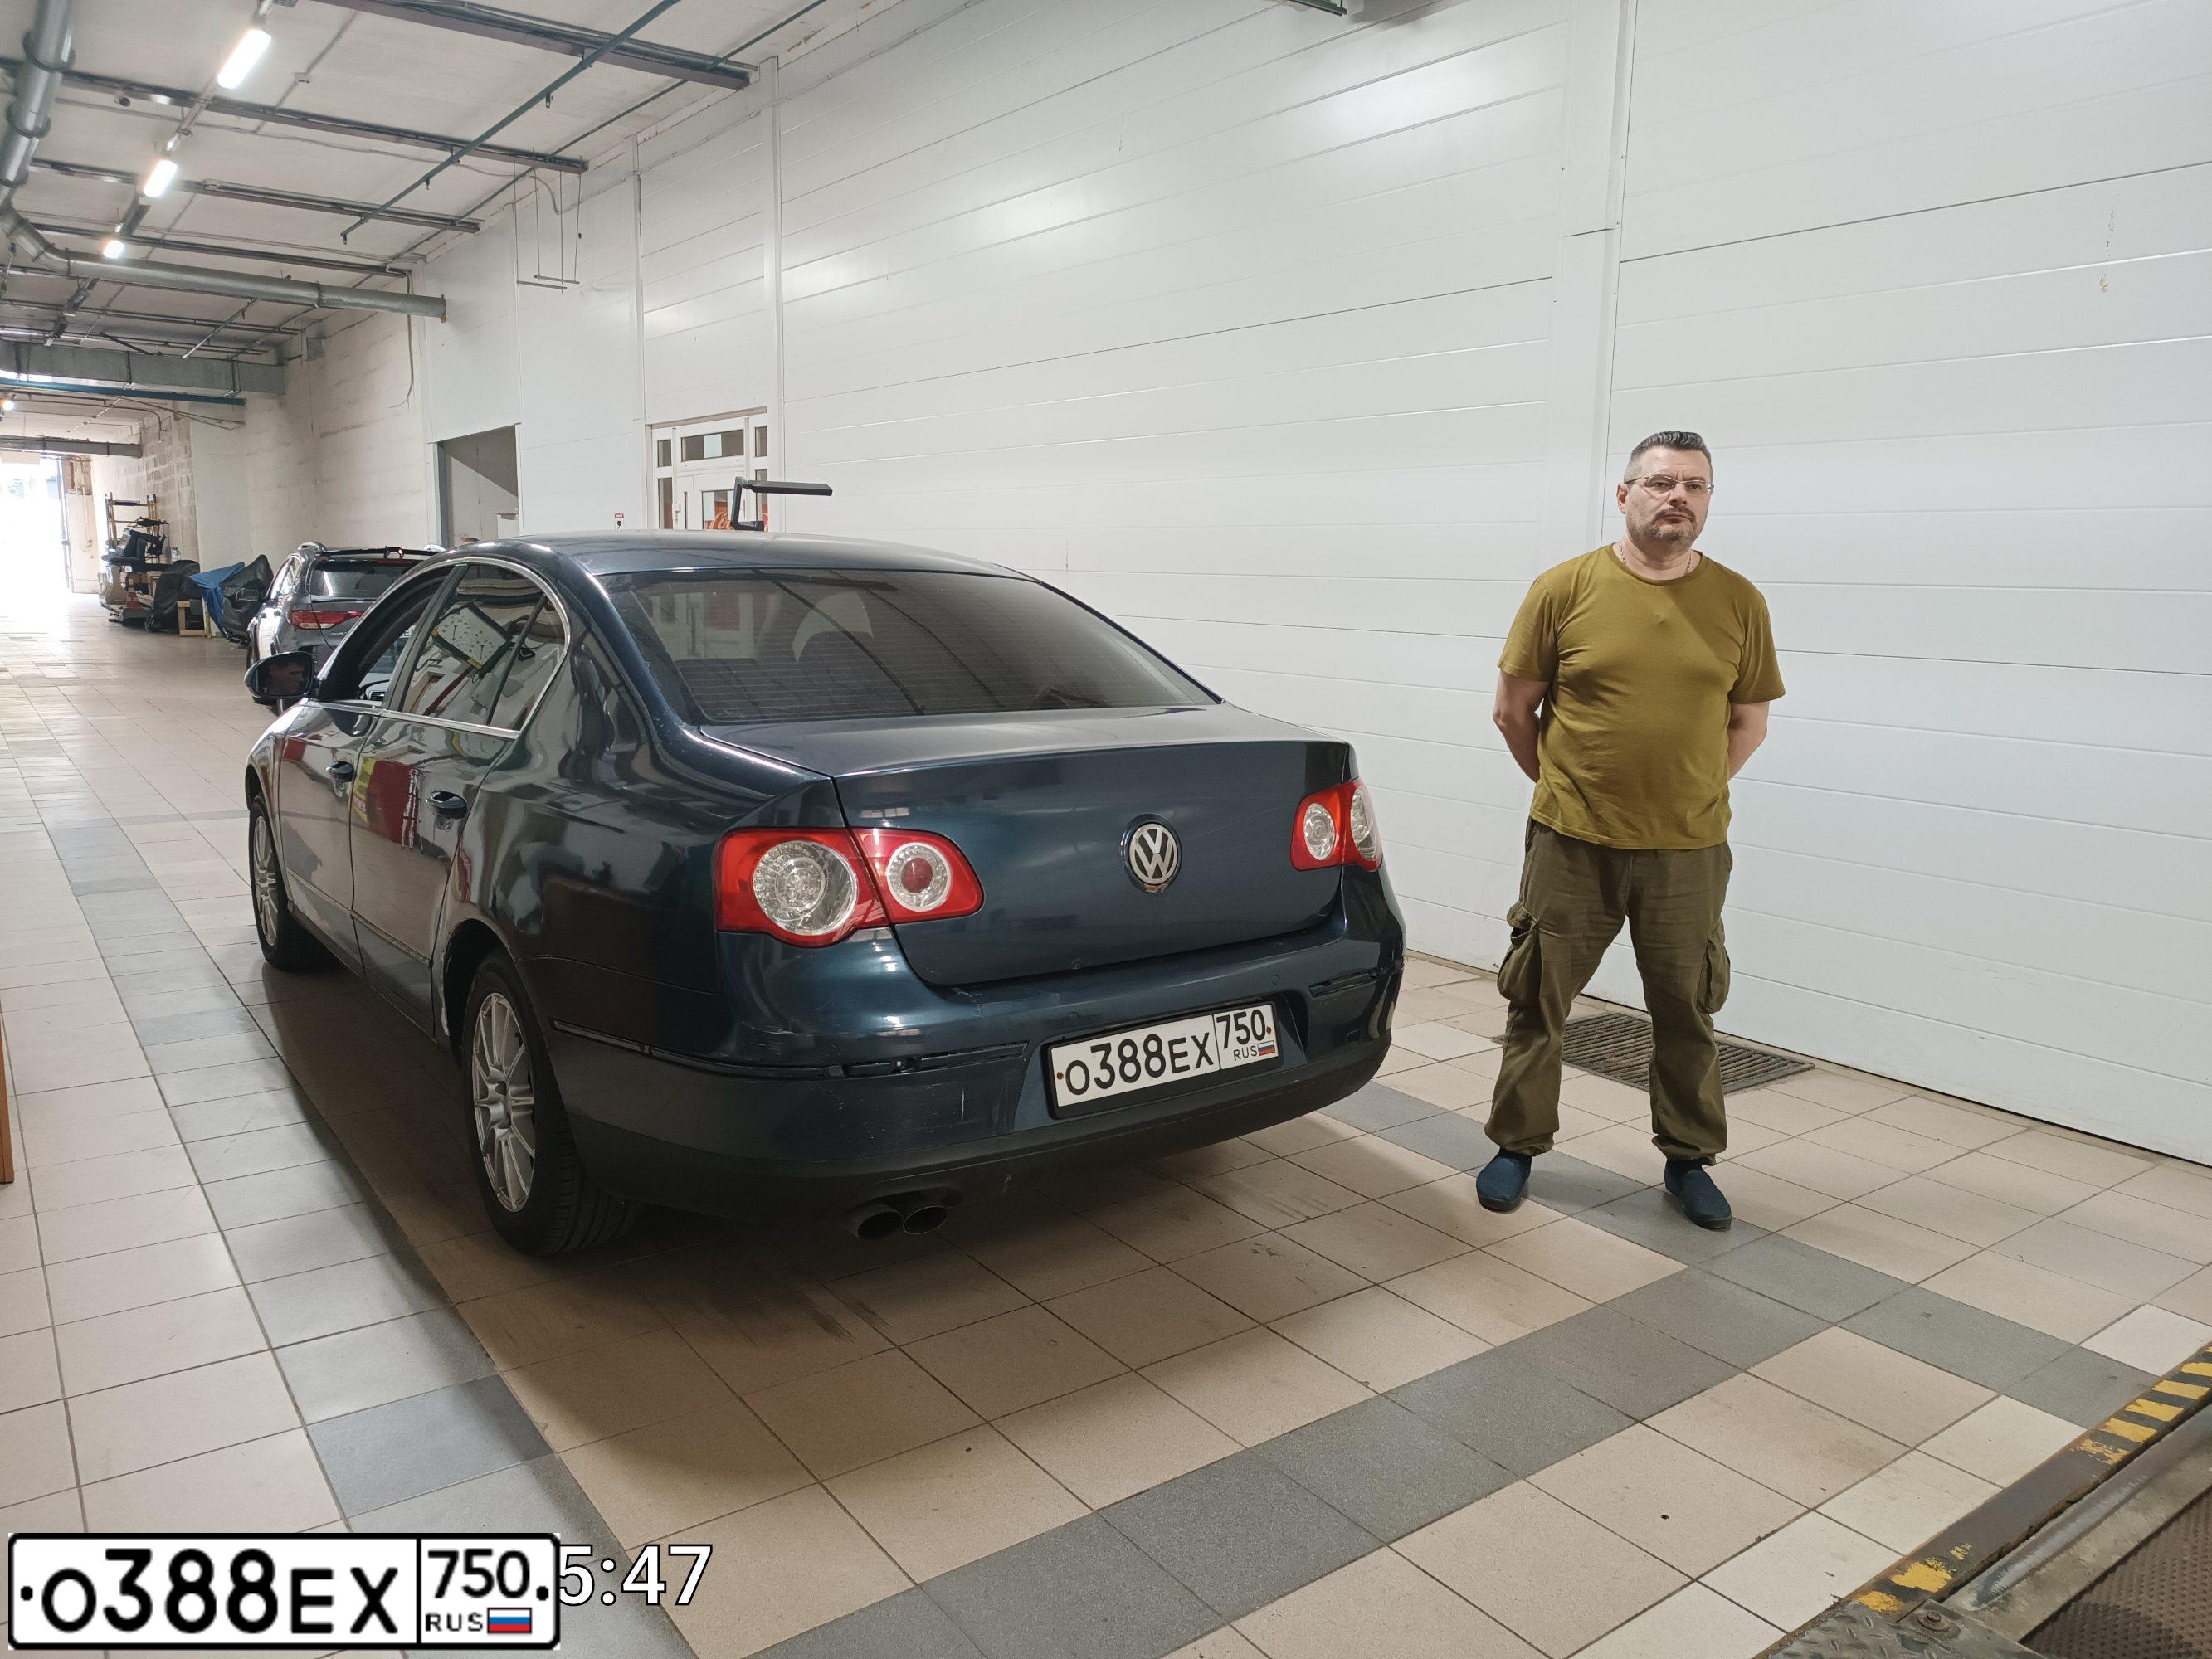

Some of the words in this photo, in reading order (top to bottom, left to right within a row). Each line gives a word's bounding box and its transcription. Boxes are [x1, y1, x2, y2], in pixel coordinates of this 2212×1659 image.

[1065, 1033, 1214, 1095] O388EX
[1216, 1010, 1266, 1049] 750
[1233, 1044, 1259, 1061] RUS
